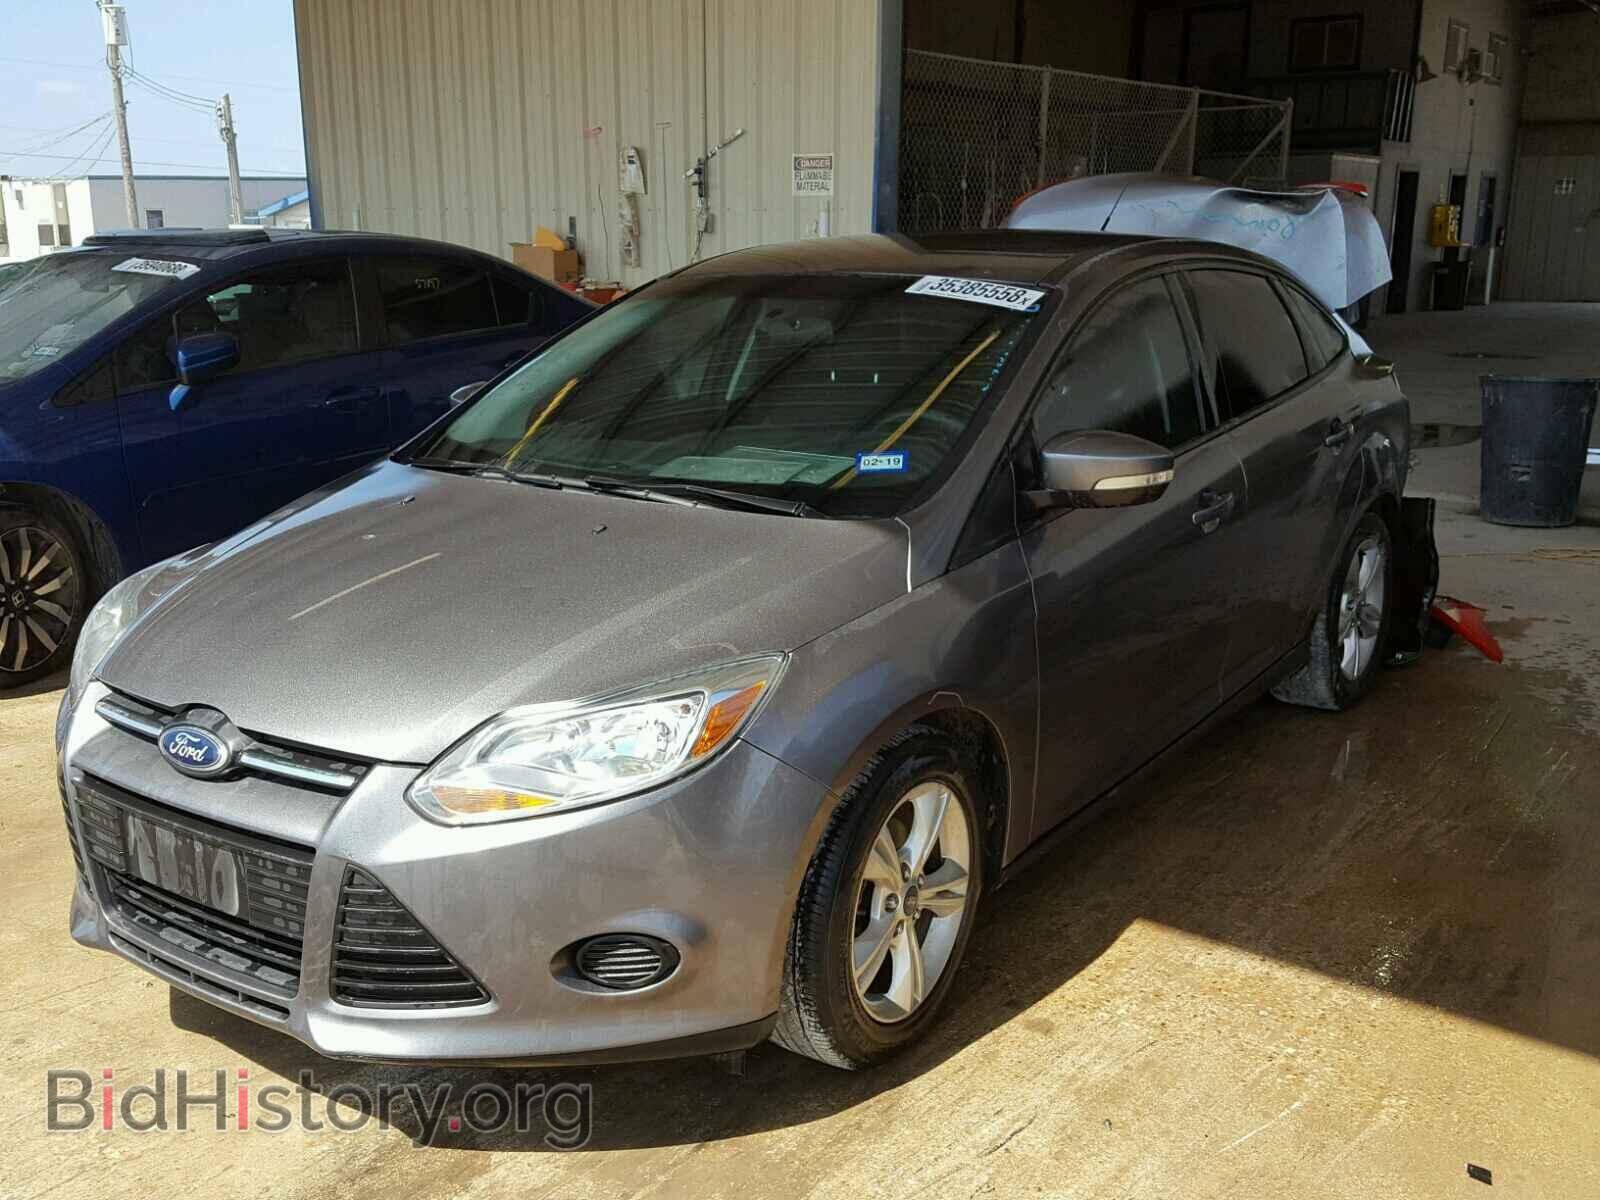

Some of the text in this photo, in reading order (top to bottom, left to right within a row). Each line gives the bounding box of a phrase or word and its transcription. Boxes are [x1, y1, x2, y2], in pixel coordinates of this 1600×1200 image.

[801, 159, 830, 169] DANGER
[795, 181, 830, 191] MATERIAL
[169, 732, 209, 762] Ford
